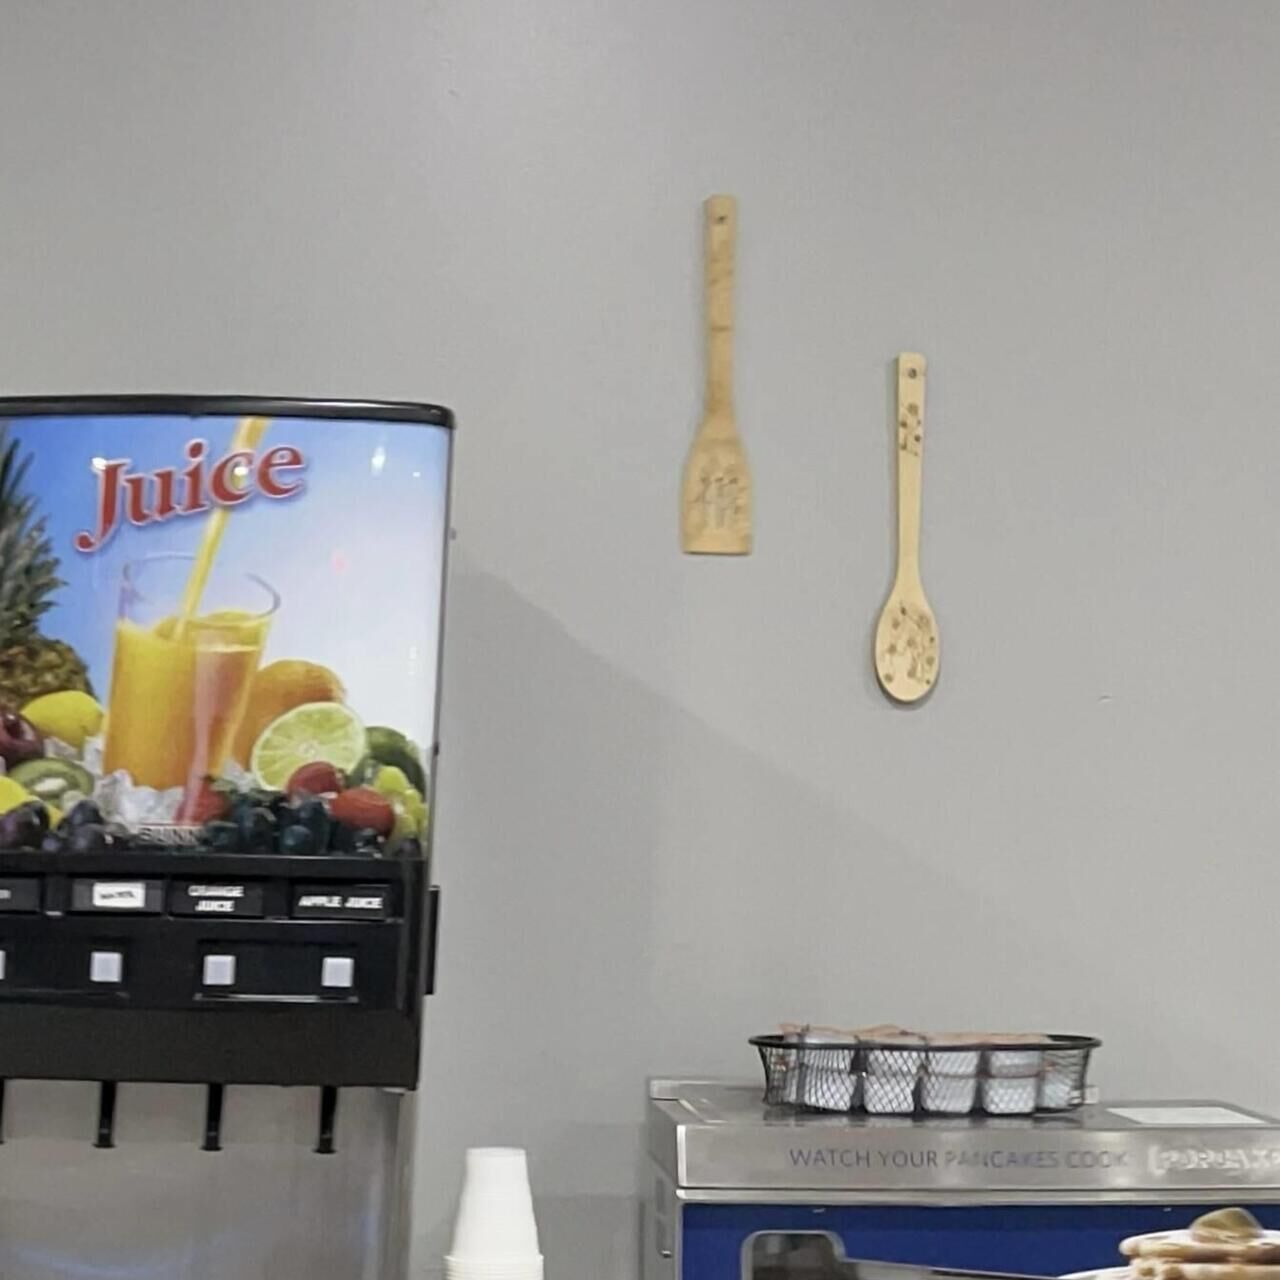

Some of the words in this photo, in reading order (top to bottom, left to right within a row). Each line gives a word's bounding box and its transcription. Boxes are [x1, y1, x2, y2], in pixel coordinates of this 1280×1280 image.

[74, 438, 305, 553] Juice
[195, 900, 235, 912] JUICE
[298, 896, 342, 907] APPLE
[344, 897, 383, 909] JUICE
[789, 1147, 871, 1169] WATCH
[877, 1148, 938, 1169] YOUR
[943, 1148, 1059, 1169] PANCAKES
[1065, 1148, 1129, 1169] COOK
